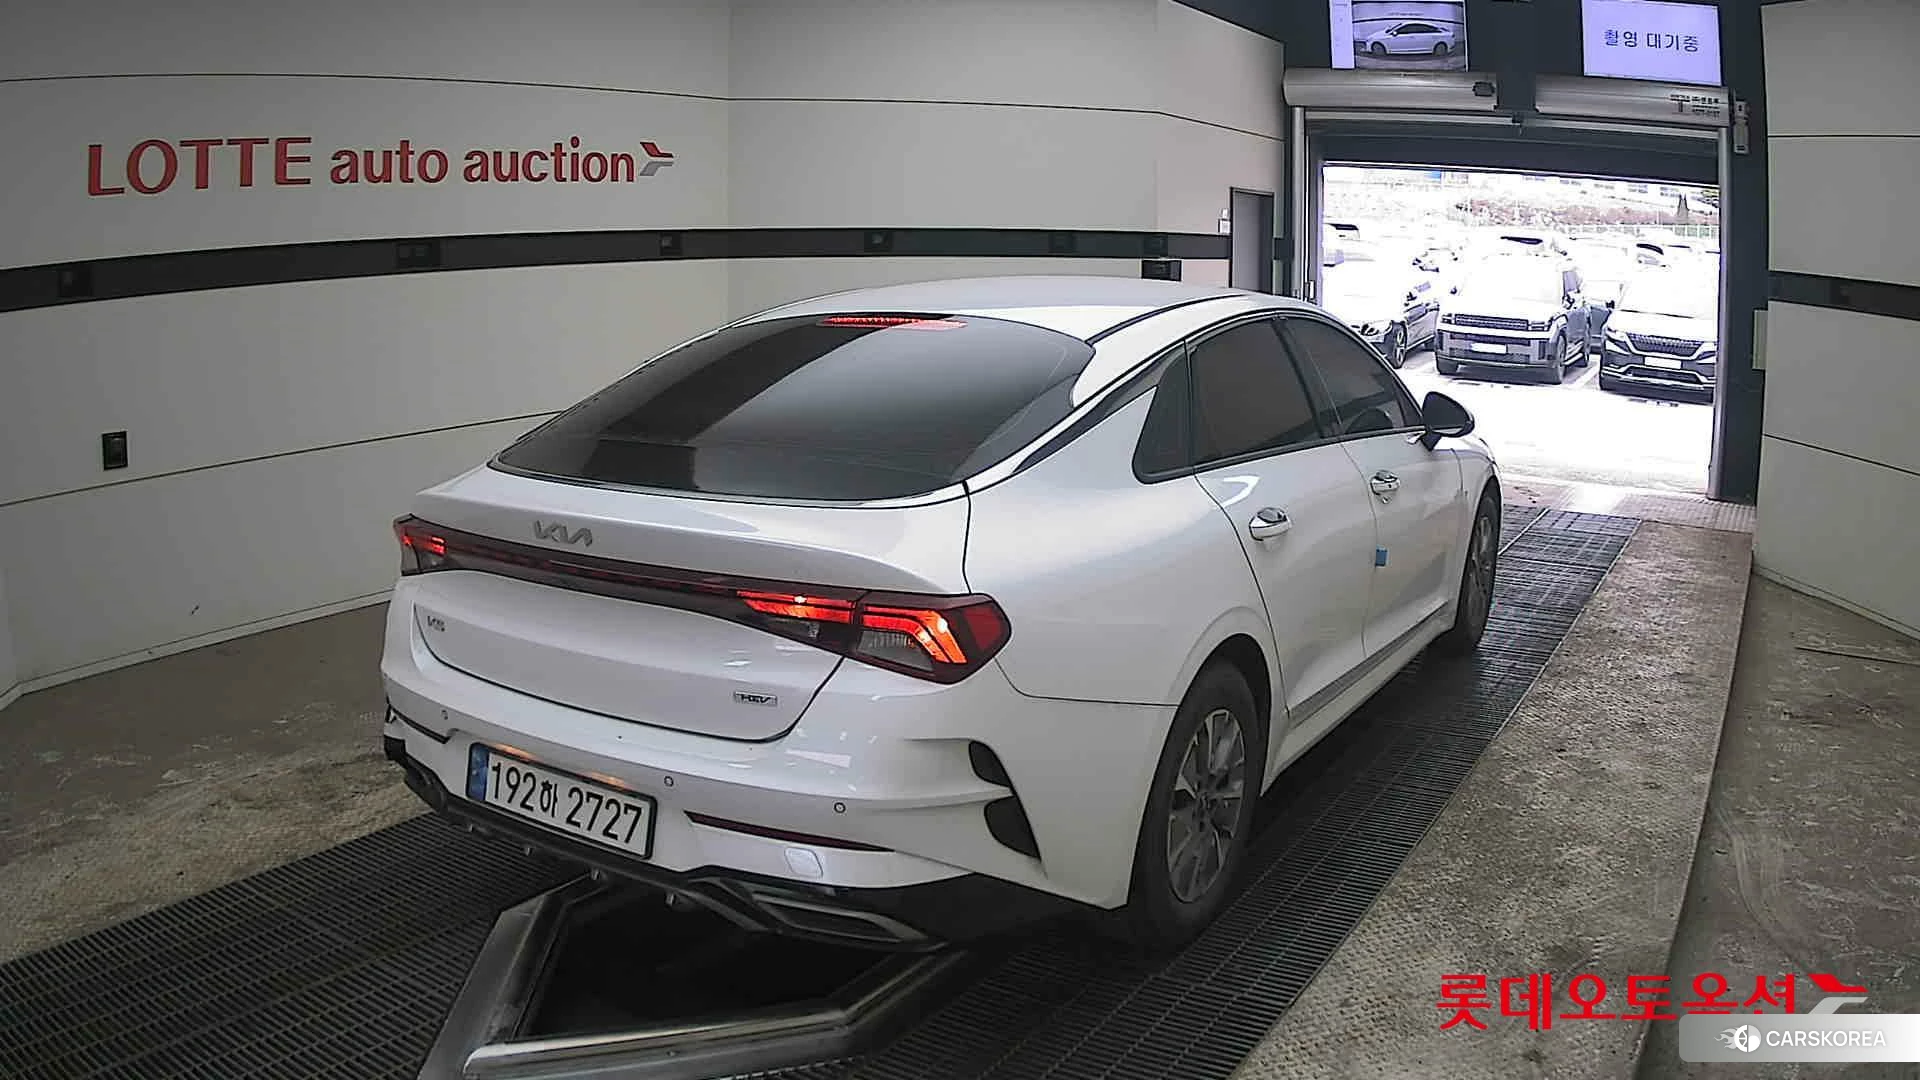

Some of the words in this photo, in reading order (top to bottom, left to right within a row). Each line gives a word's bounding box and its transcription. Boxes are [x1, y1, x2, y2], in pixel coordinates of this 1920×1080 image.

[1646, 32, 1699, 52] 대기중
[87, 136, 312, 197] LOTTE
[330, 139, 450, 184] auto
[463, 136, 636, 183] auction
[533, 519, 593, 547] KIA
[492, 761, 559, 818] 192하
[565, 786, 643, 844] 2727
